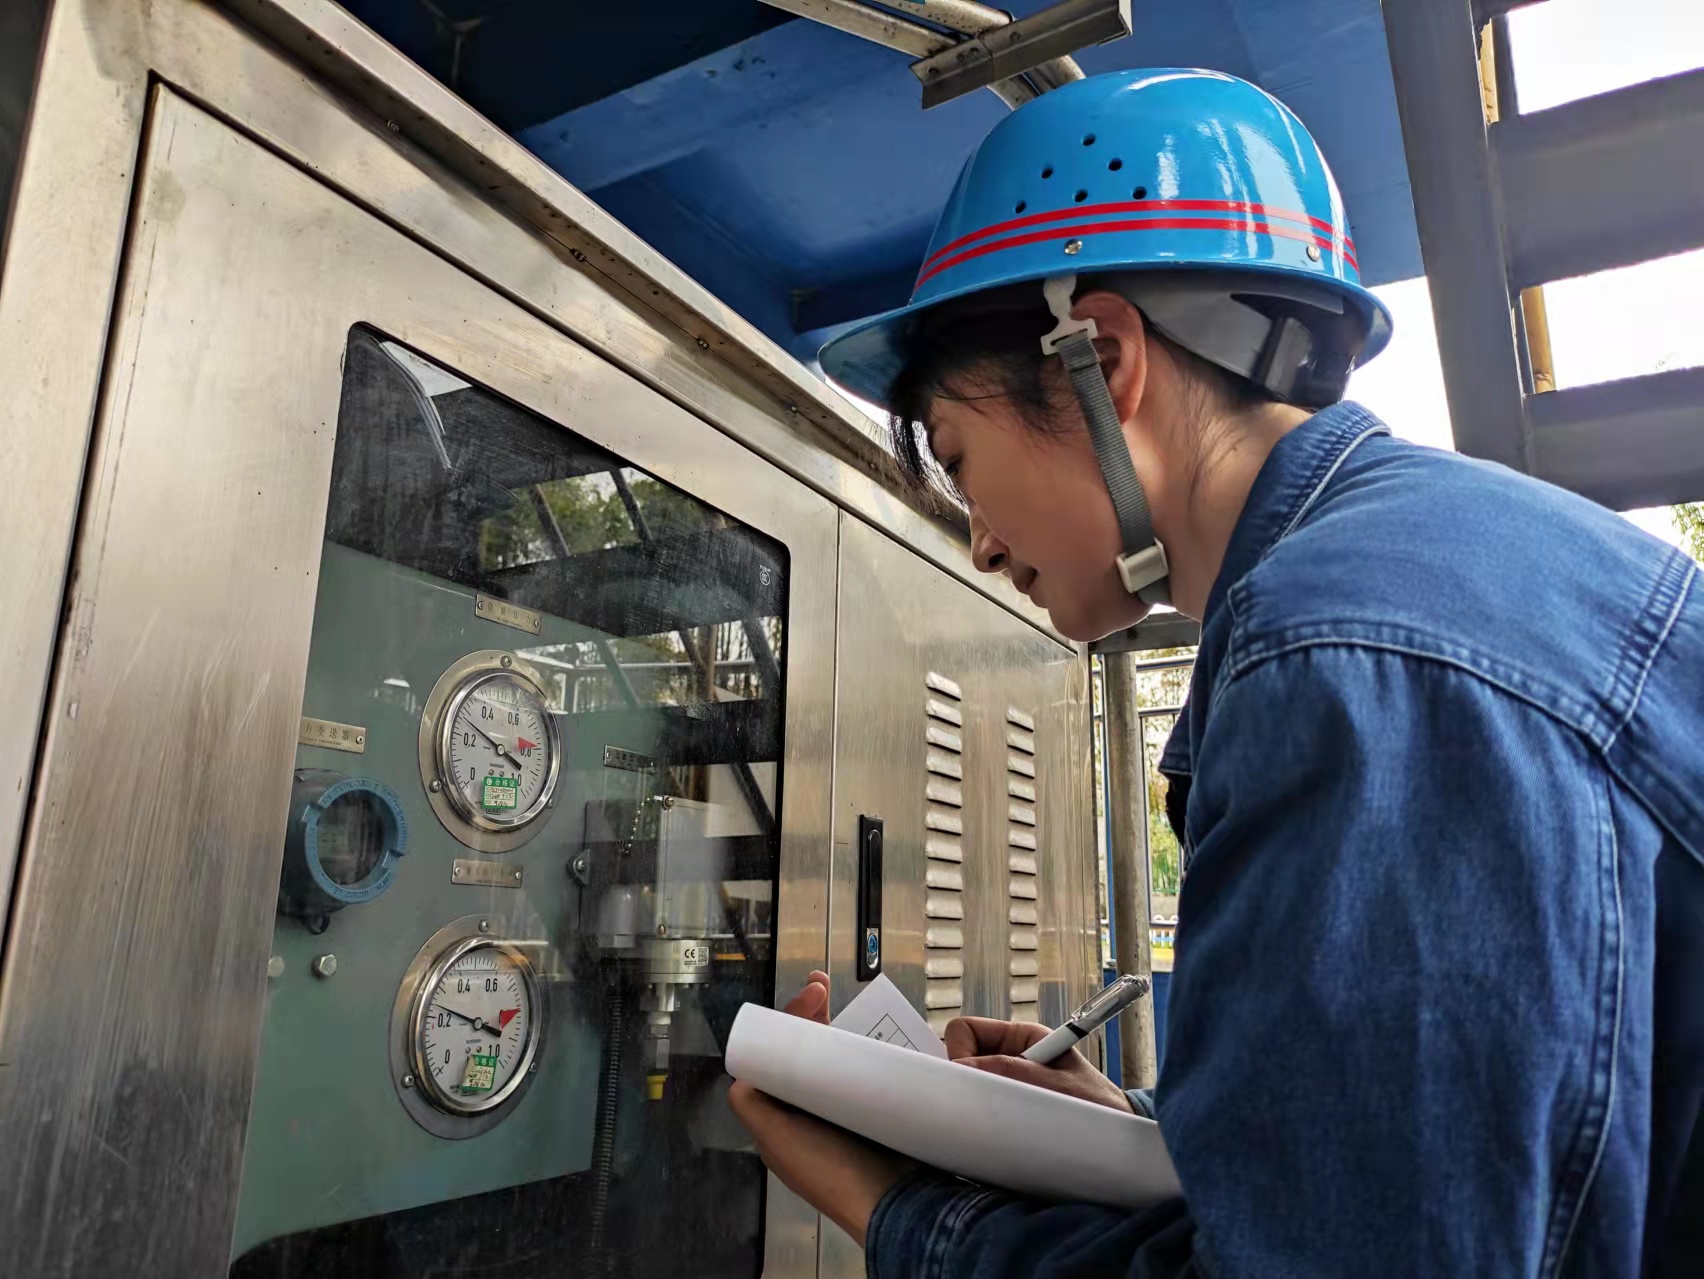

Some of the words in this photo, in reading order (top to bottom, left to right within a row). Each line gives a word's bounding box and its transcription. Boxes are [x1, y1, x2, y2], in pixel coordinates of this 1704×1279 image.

[481, 706, 494, 720] 0.4
[508, 712, 519, 725] 0.6
[463, 732, 476, 747] 0.2
[470, 767, 475, 780] 0
[457, 978, 471, 993] 0.4
[485, 978, 498, 992] 0.6
[437, 1013, 451, 1028] 0.2
[444, 1049, 451, 1064] 0
